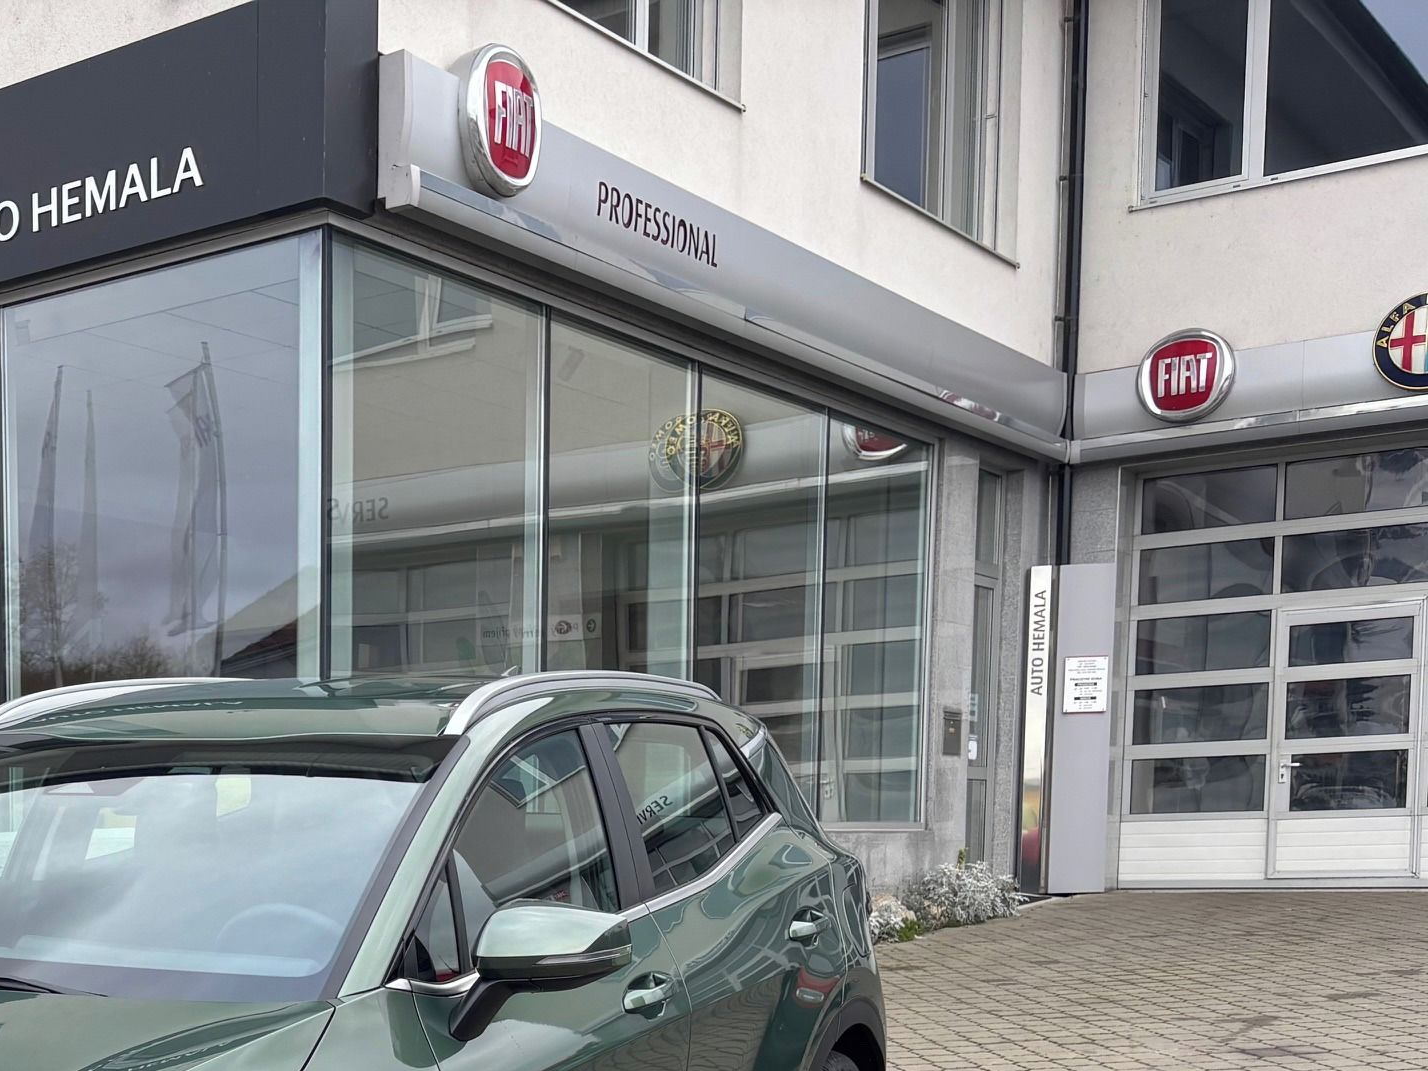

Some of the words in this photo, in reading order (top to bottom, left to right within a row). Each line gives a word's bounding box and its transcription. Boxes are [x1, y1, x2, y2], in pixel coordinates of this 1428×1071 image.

[494, 80, 535, 159] FIAT
[31, 146, 204, 233] HEMALA
[597, 181, 718, 268] PROFESSIONAL
[1376, 302, 1416, 348] ALFA
[1157, 352, 1213, 398] FIAT
[1032, 590, 1047, 651] HEMALA
[1030, 657, 1044, 696] AUTO
